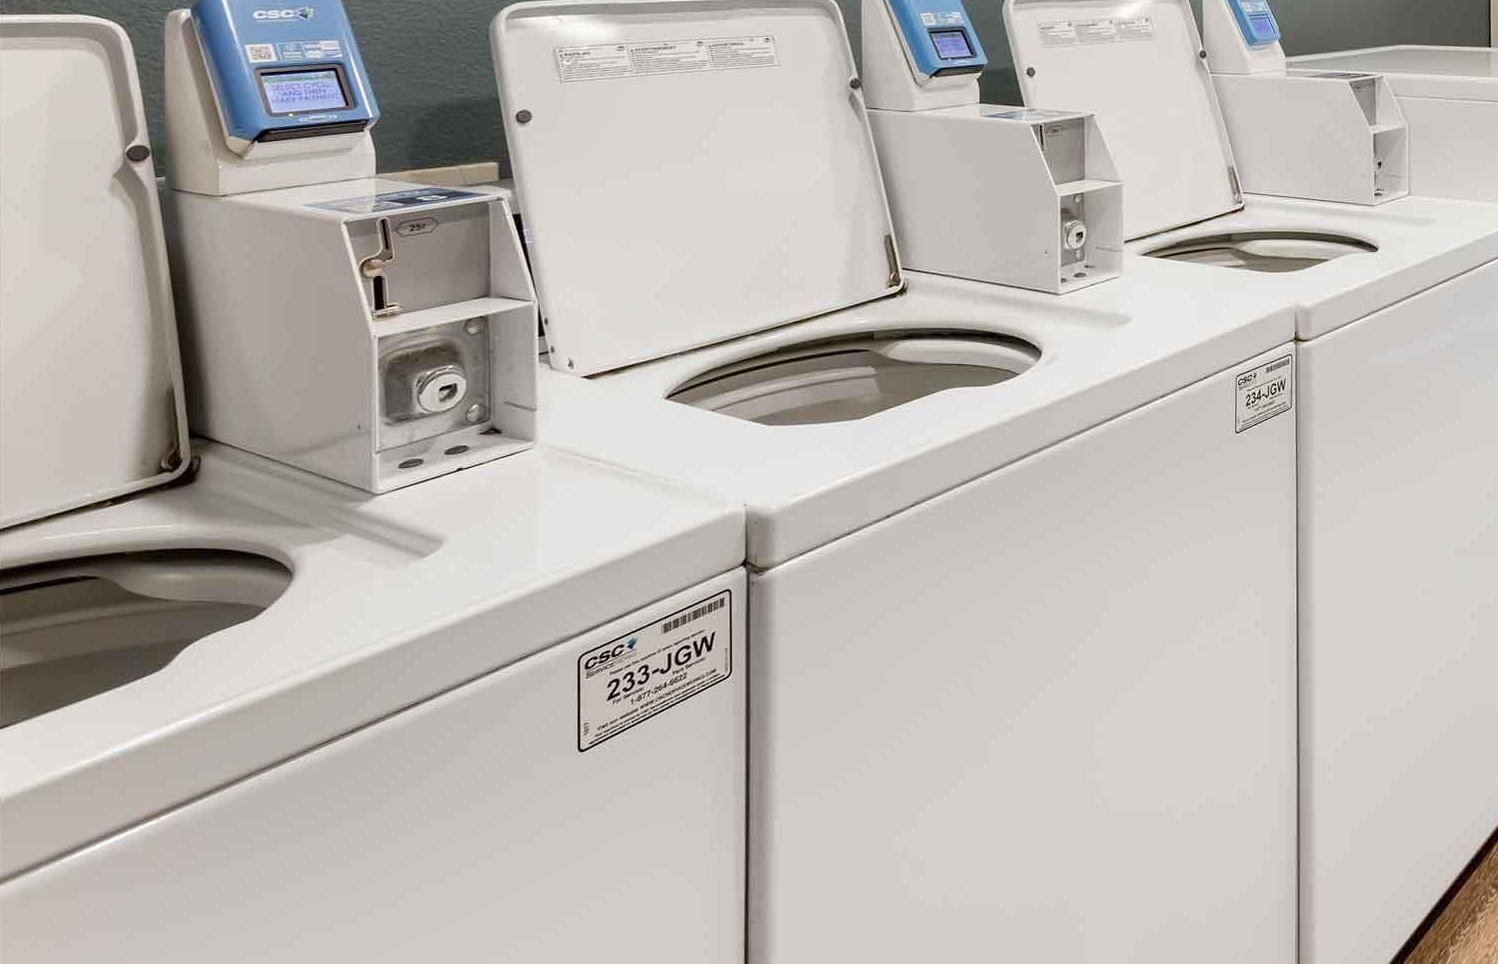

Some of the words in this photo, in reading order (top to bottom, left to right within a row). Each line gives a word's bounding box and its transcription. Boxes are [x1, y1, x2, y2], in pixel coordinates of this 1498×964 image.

[253, 9, 295, 20] CSC
[1237, 374, 1252, 385] CSC
[1245, 378, 1285, 406] 234-JGW
[584, 643, 623, 670] CSC
[607, 631, 715, 700] 233-JGW
